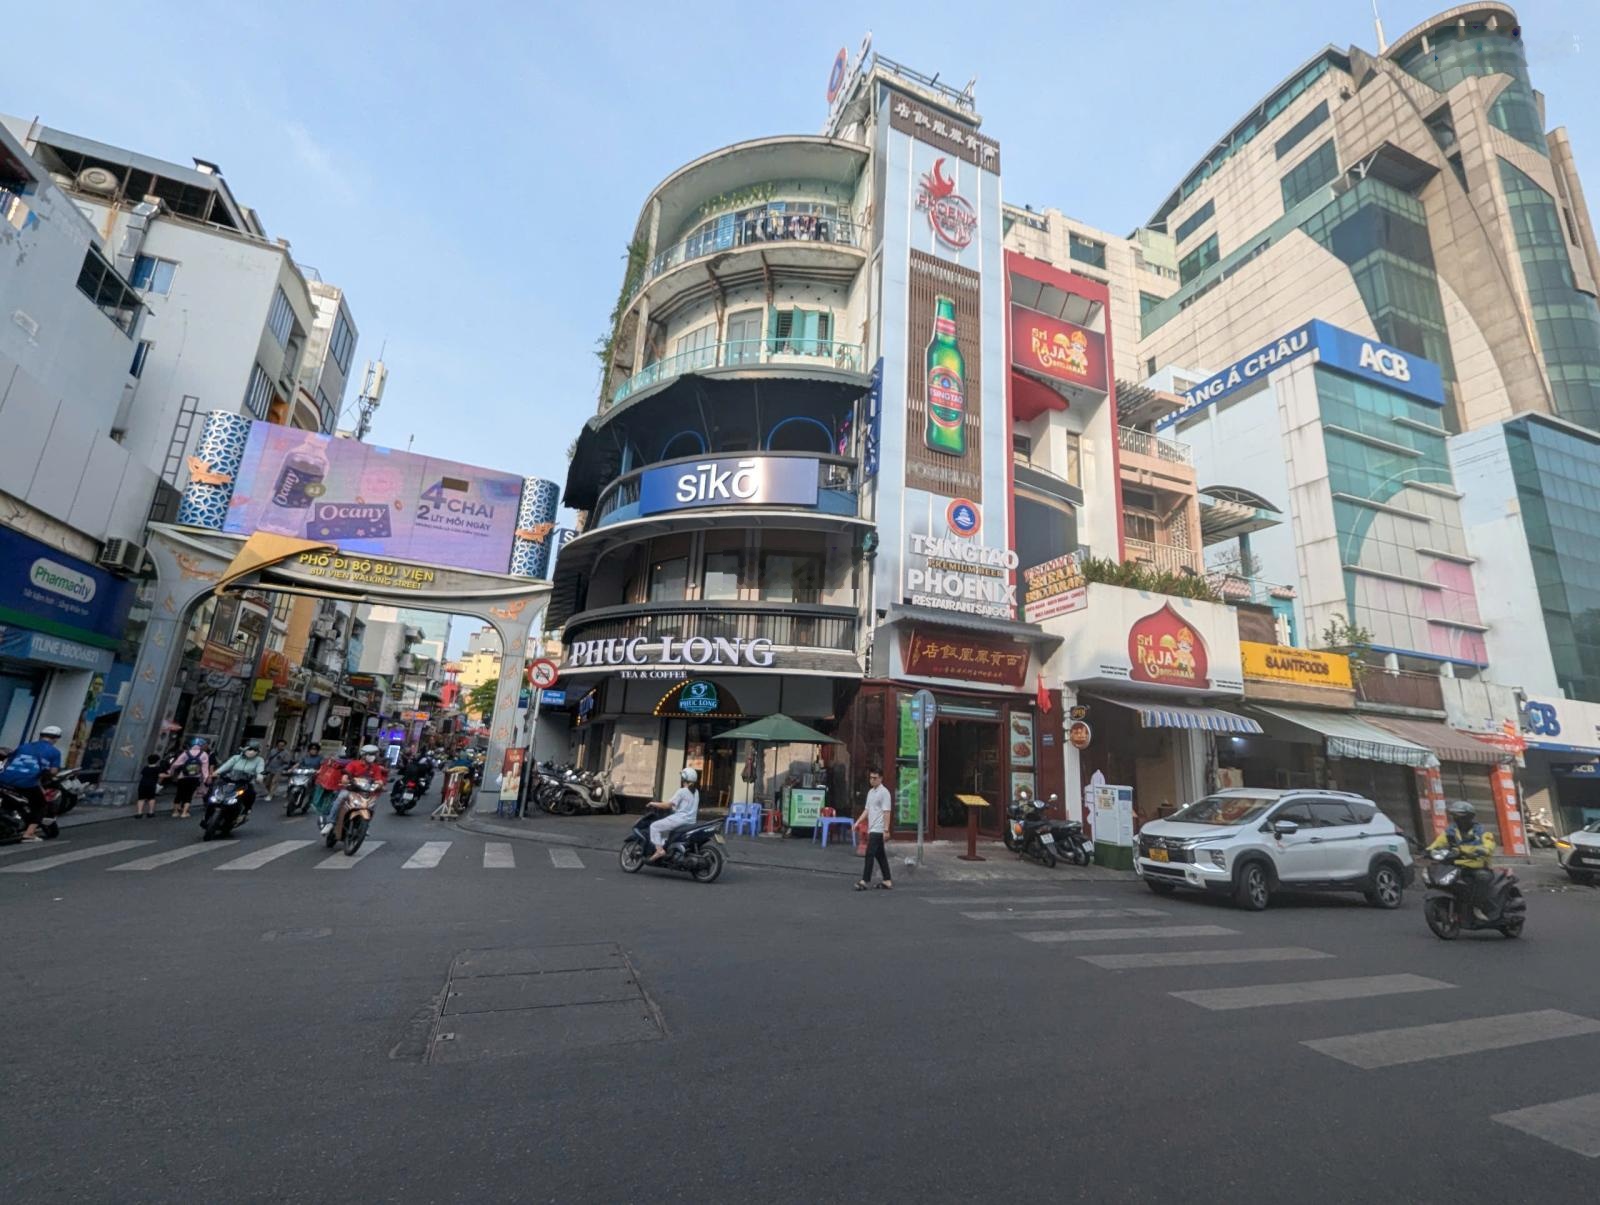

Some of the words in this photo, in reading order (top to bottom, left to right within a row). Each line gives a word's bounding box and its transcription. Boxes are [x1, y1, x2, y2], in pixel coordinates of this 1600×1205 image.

[1227, 366, 1242, 389] Á
[1244, 331, 1309, 377] CHÂU
[1359, 342, 1411, 382] ACB
[320, 504, 386, 523] Ocany
[417, 505, 431, 520] 2
[447, 499, 495, 519] CHAI
[910, 533, 1019, 570] TSINGTAO
[928, 558, 976, 574] PREMIUM
[34, 565, 91, 600] Pharmacity
[352, 572, 391, 585] WALKING
[393, 579, 423, 590] STREET
[907, 568, 1018, 606] PHOENIX
[912, 594, 975, 613] RESTAURANT
[659, 636, 776, 667] LONG
[621, 671, 638, 679] TEA
[640, 671, 648, 679] &
[650, 670, 687, 679] COFFEE
[699, 699, 717, 708] LONG
[1524, 700, 1561, 736] CB
